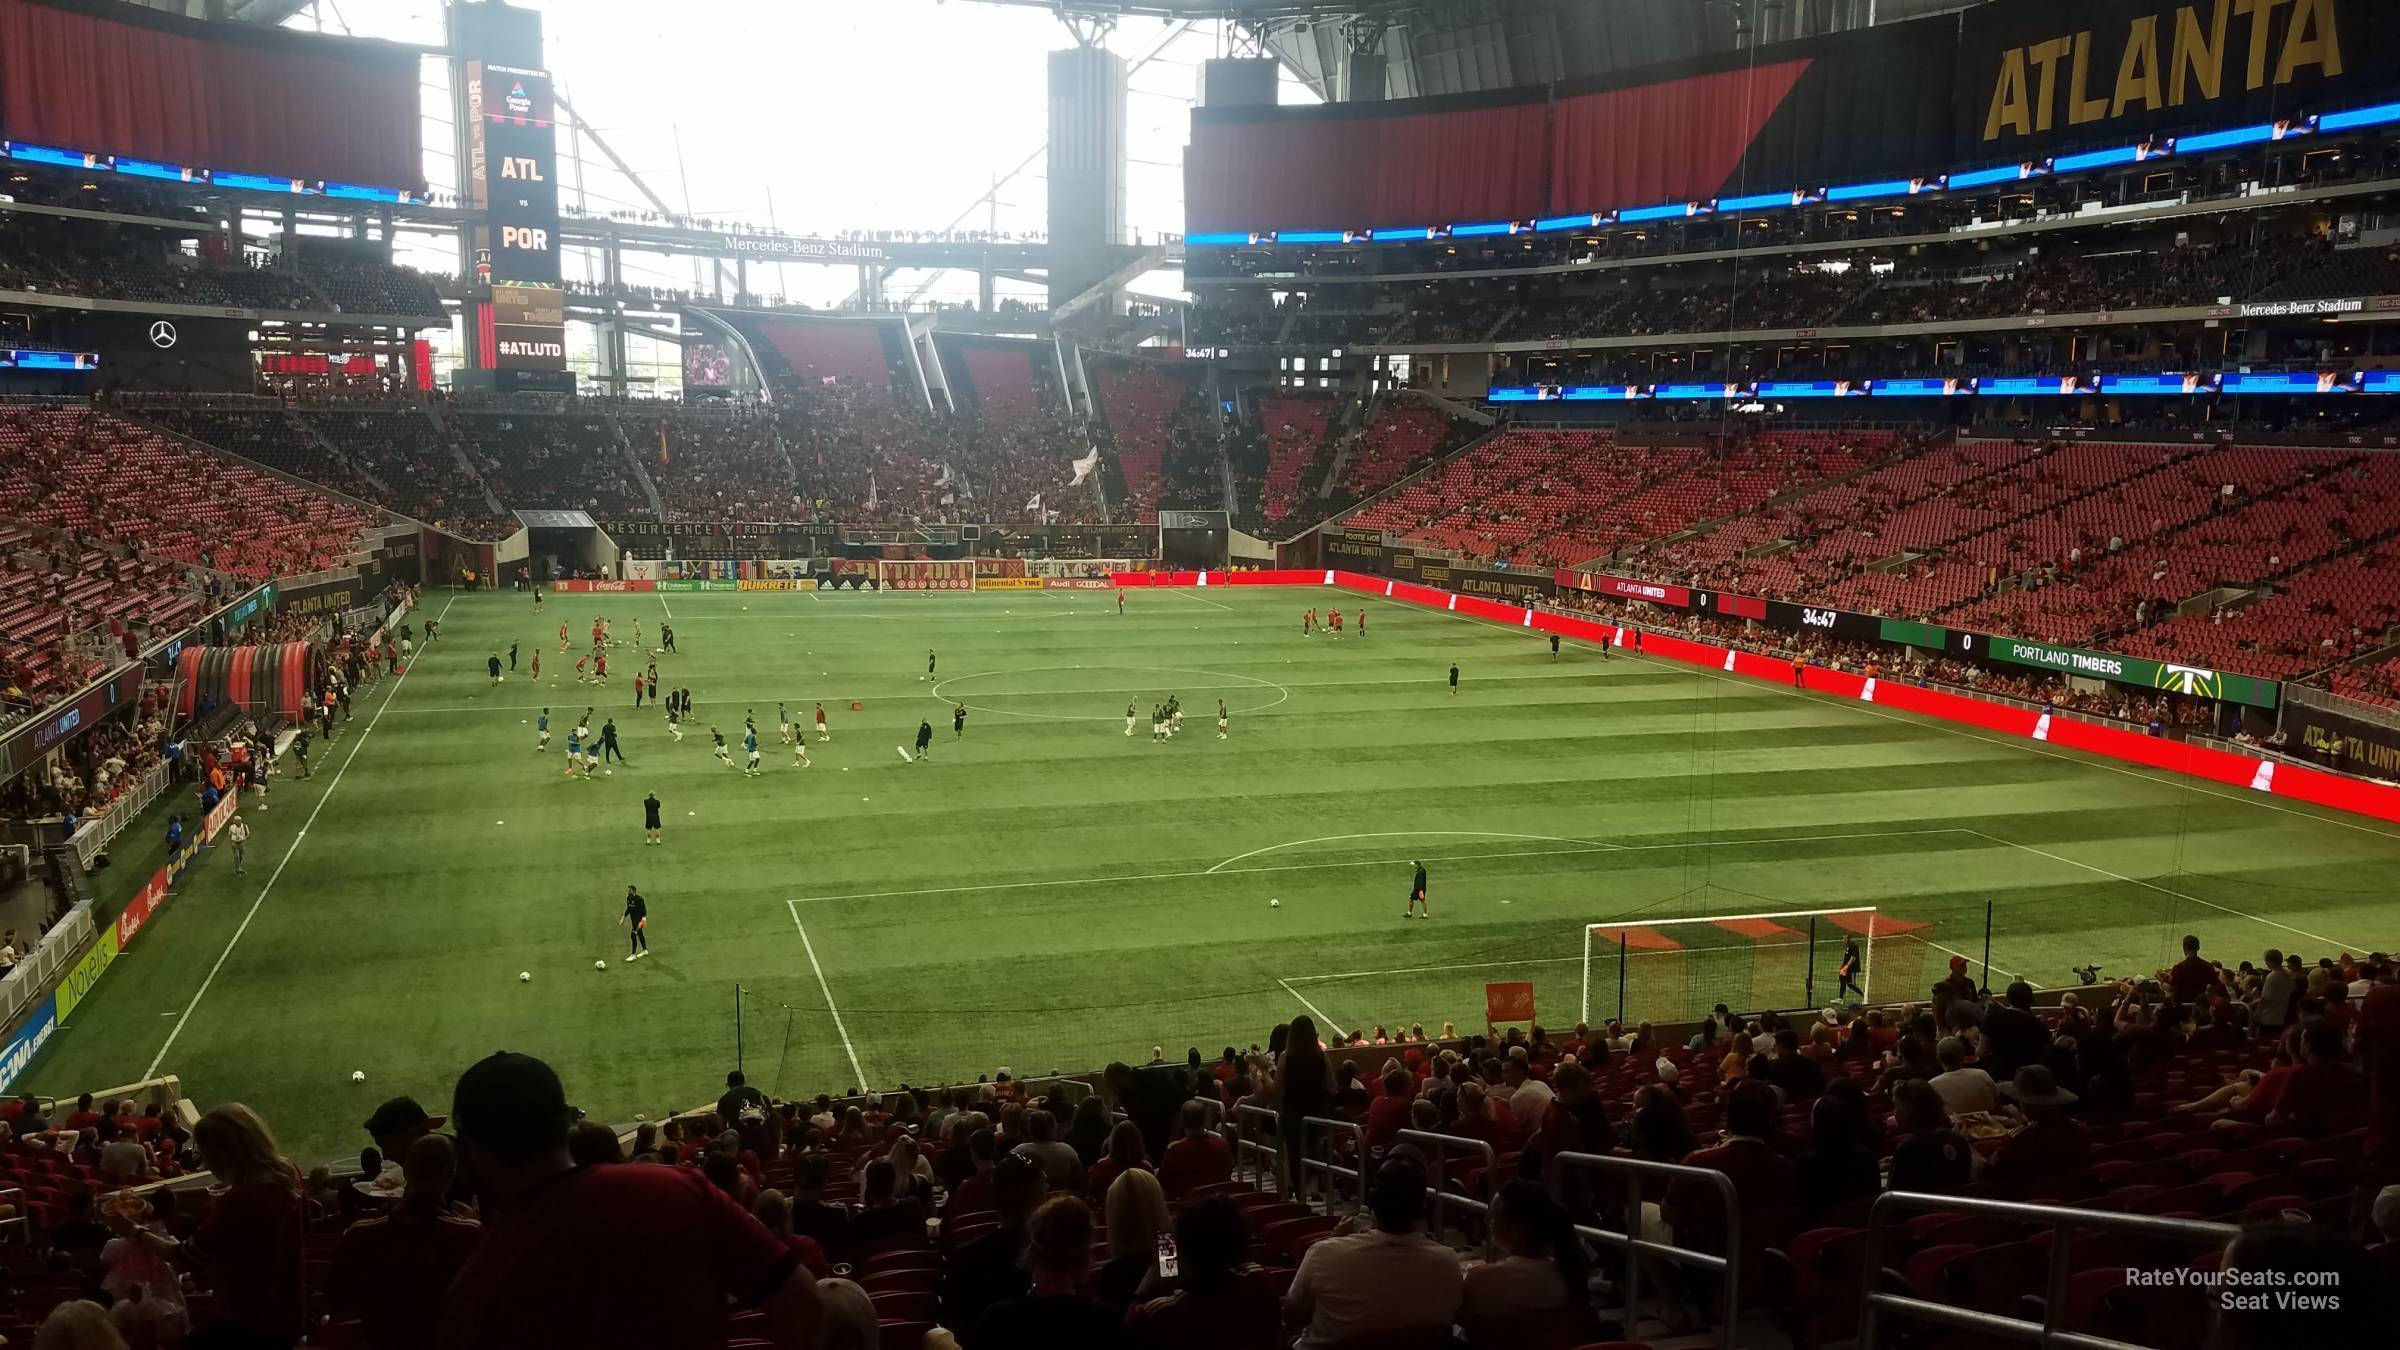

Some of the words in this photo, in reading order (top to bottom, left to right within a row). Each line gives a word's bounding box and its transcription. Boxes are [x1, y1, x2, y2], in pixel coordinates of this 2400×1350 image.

[1983, 0, 2344, 141] ATLANTA
[506, 95, 532, 106] Georgia
[509, 103, 529, 112] Power
[472, 140, 486, 180] ATL
[501, 156, 543, 181] ATL
[503, 226, 548, 251] POR
[725, 236, 825, 254] Mercedes-Benz
[828, 242, 883, 258] Stadium
[2240, 302, 2315, 317] Mercedes-Benz
[2317, 299, 2362, 312] Stadium
[499, 341, 562, 357] #ATLUTD
[1186, 348, 1211, 359] 34:47
[607, 523, 712, 536] RESURGENCE
[744, 525, 783, 535] ROWDY
[802, 525, 834, 536] PROUD
[1345, 532, 1366, 542] FOOTIE
[1328, 542, 1360, 555] ATLANTA
[1028, 562, 1050, 575] HERE
[738, 579, 797, 591] QUIKRETE
[975, 577, 1016, 588] ontinental
[1461, 578, 1502, 594] ATLANTA
[1616, 581, 1642, 594] ATLANTA
[1642, 586, 1666, 599] UNITED
[289, 596, 323, 615] ATLANTA
[323, 590, 351, 609] UNITED
[1700, 593, 1707, 606] 0
[1802, 608, 1837, 629] 34:47
[1963, 634, 1972, 650] 0
[2013, 644, 2069, 666] PORTLAND
[2071, 653, 2122, 675] TIMBERS
[33, 721, 61, 752] ATLANTA
[59, 708, 80, 734] UNITED
[68, 942, 108, 1008] Novelis
[33, 1015, 55, 1049] ENERGY
